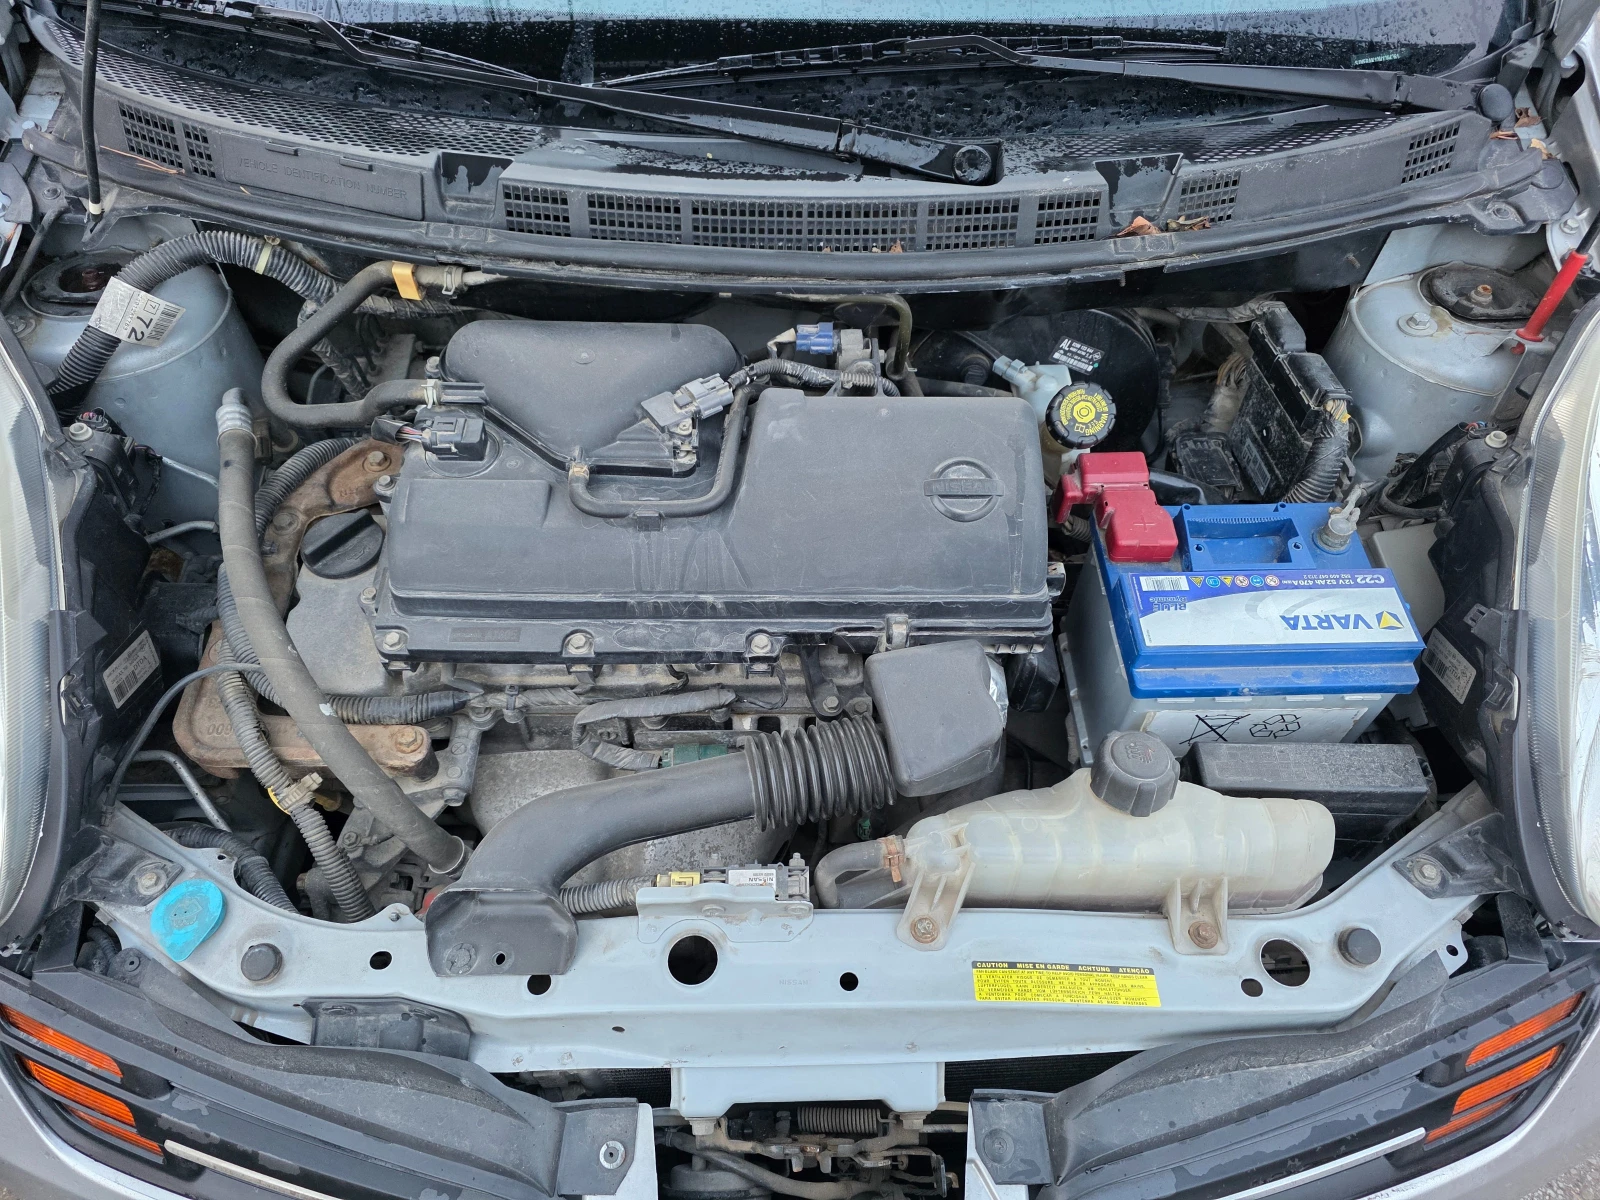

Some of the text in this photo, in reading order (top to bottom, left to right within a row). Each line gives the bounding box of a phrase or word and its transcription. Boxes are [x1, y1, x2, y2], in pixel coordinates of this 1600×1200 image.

[238, 158, 407, 200] VEHICLE IDENTIFICATION NUMBER
[128, 316, 154, 341] 72
[1085, 413, 1109, 436] WARNING
[933, 480, 997, 493] NISSAN
[1355, 574, 1385, 584] C22
[1153, 602, 1186, 611] BLUE
[1280, 613, 1373, 630] VARTA
